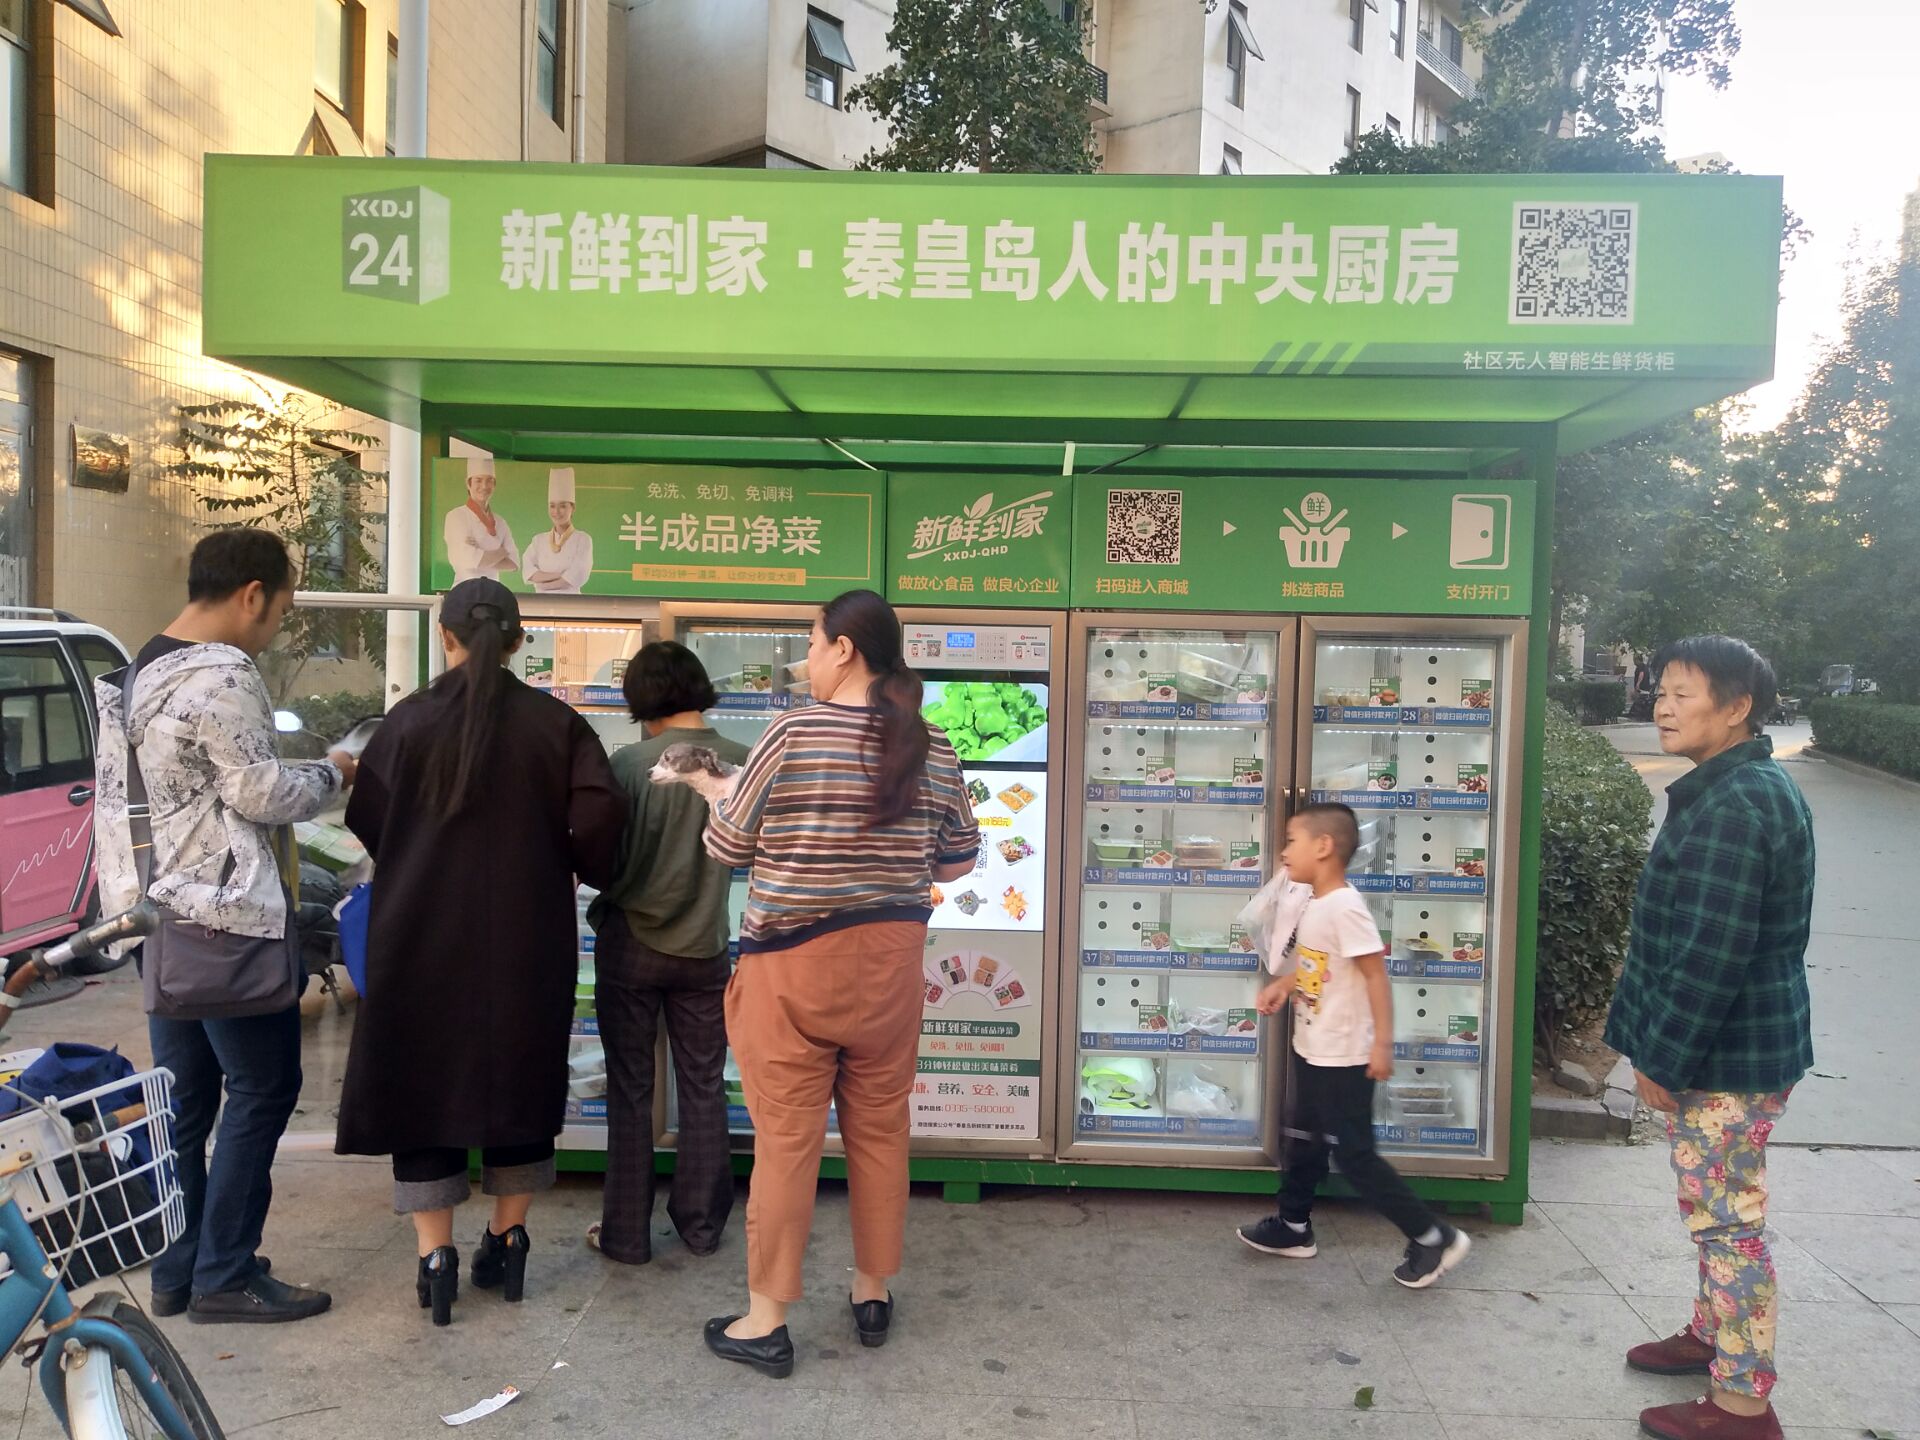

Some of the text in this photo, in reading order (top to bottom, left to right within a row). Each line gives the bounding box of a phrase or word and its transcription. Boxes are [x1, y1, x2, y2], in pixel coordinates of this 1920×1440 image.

[349, 232, 413, 287] 24
[1463, 351, 1676, 372] 社区无人智能生鲜货柜
[647, 482, 795, 503] 免洗、免切、免调料
[1305, 496, 1326, 517] 鲜
[911, 503, 1049, 549] 新鲜到家
[617, 510, 822, 556] 半成品净菜
[943, 545, 1009, 562] XXDJ-QHD
[898, 575, 1059, 593] 做放心食品 做良心企业
[1096, 578, 1189, 595] 扫码进入商城
[1281, 581, 1345, 598] 挑选商品
[1446, 584, 1511, 600] 支付开门
[552, 689, 566, 699] 02
[774, 696, 787, 706] 04
[1090, 704, 1104, 714] 25
[1179, 705, 1193, 715] 26
[1402, 710, 1416, 721] 28
[1089, 787, 1102, 797] 29
[1177, 788, 1190, 799] 30
[1400, 794, 1413, 805] 32
[1087, 870, 1100, 880] 33
[1174, 871, 1188, 882] 34
[1396, 878, 1410, 888] 36
[1084, 952, 1097, 962] 37
[1172, 954, 1185, 965] 38
[1082, 1035, 1095, 1046] 41
[1170, 1037, 1183, 1048] 42
[1080, 1117, 1093, 1128] 45
[1388, 1130, 1402, 1141] 48
